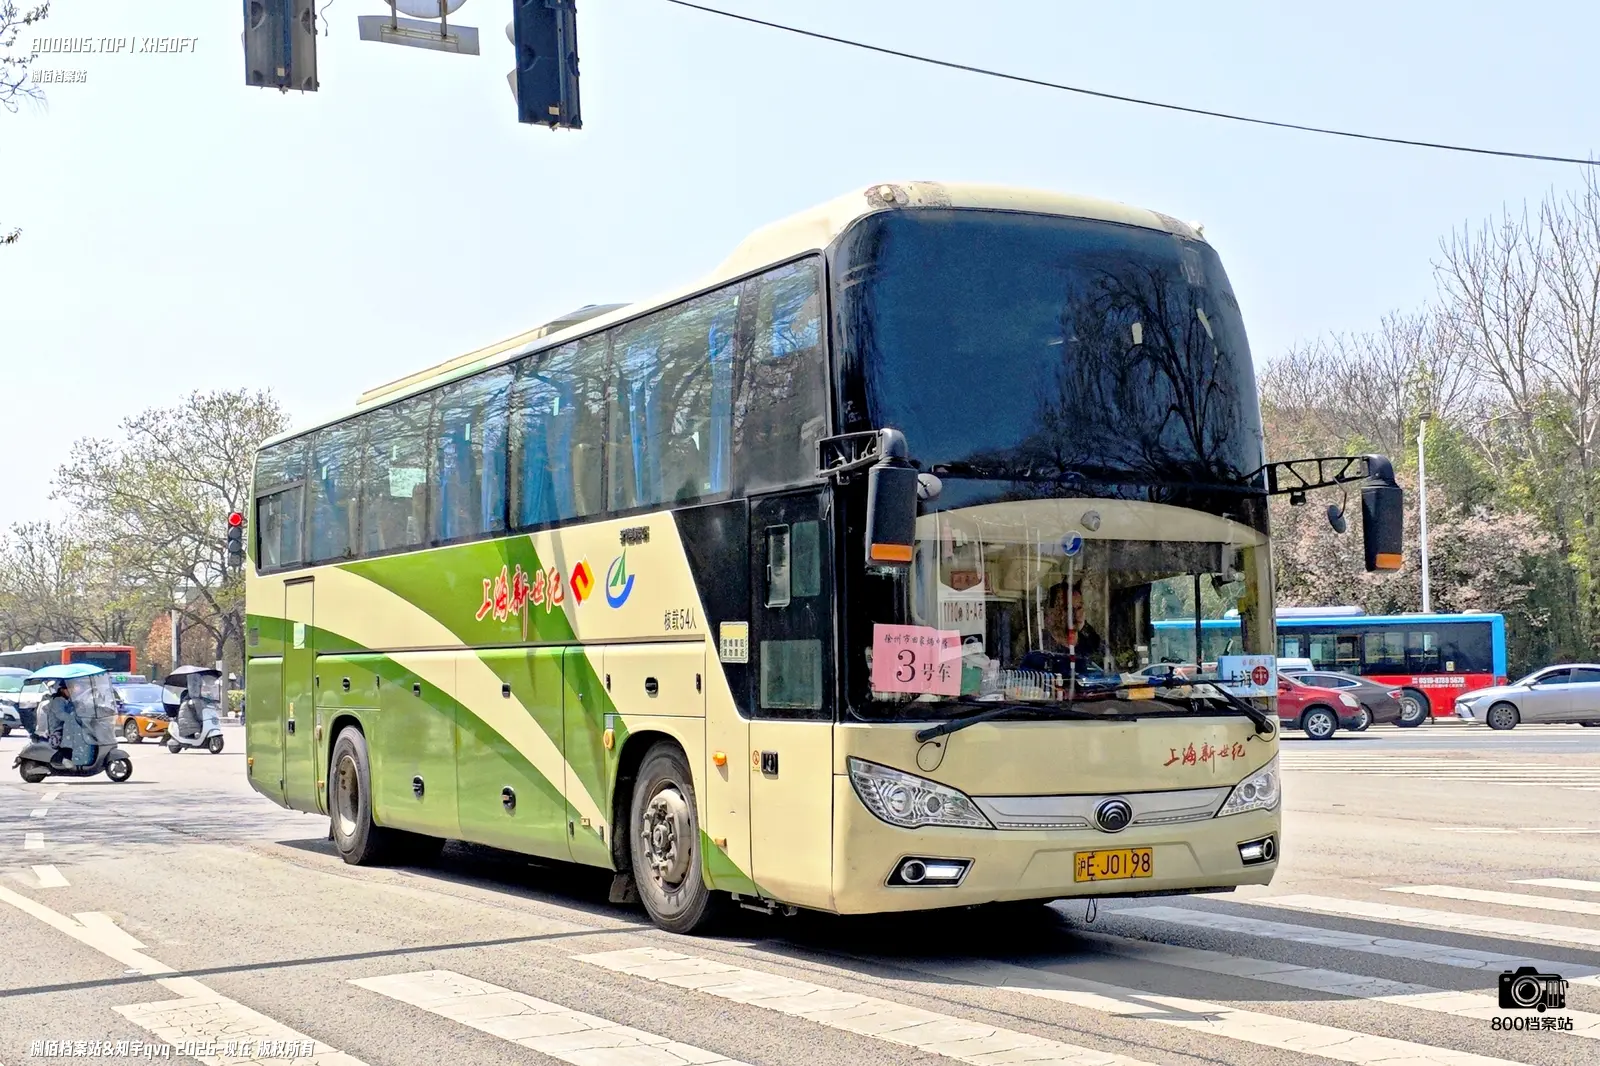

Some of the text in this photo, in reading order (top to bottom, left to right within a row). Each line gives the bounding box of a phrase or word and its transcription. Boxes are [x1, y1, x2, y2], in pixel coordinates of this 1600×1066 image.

[475, 564, 565, 641] 上海新世纪
[663, 607, 697, 631] 核载54人
[1163, 742, 1246, 773] 上海新世纪
